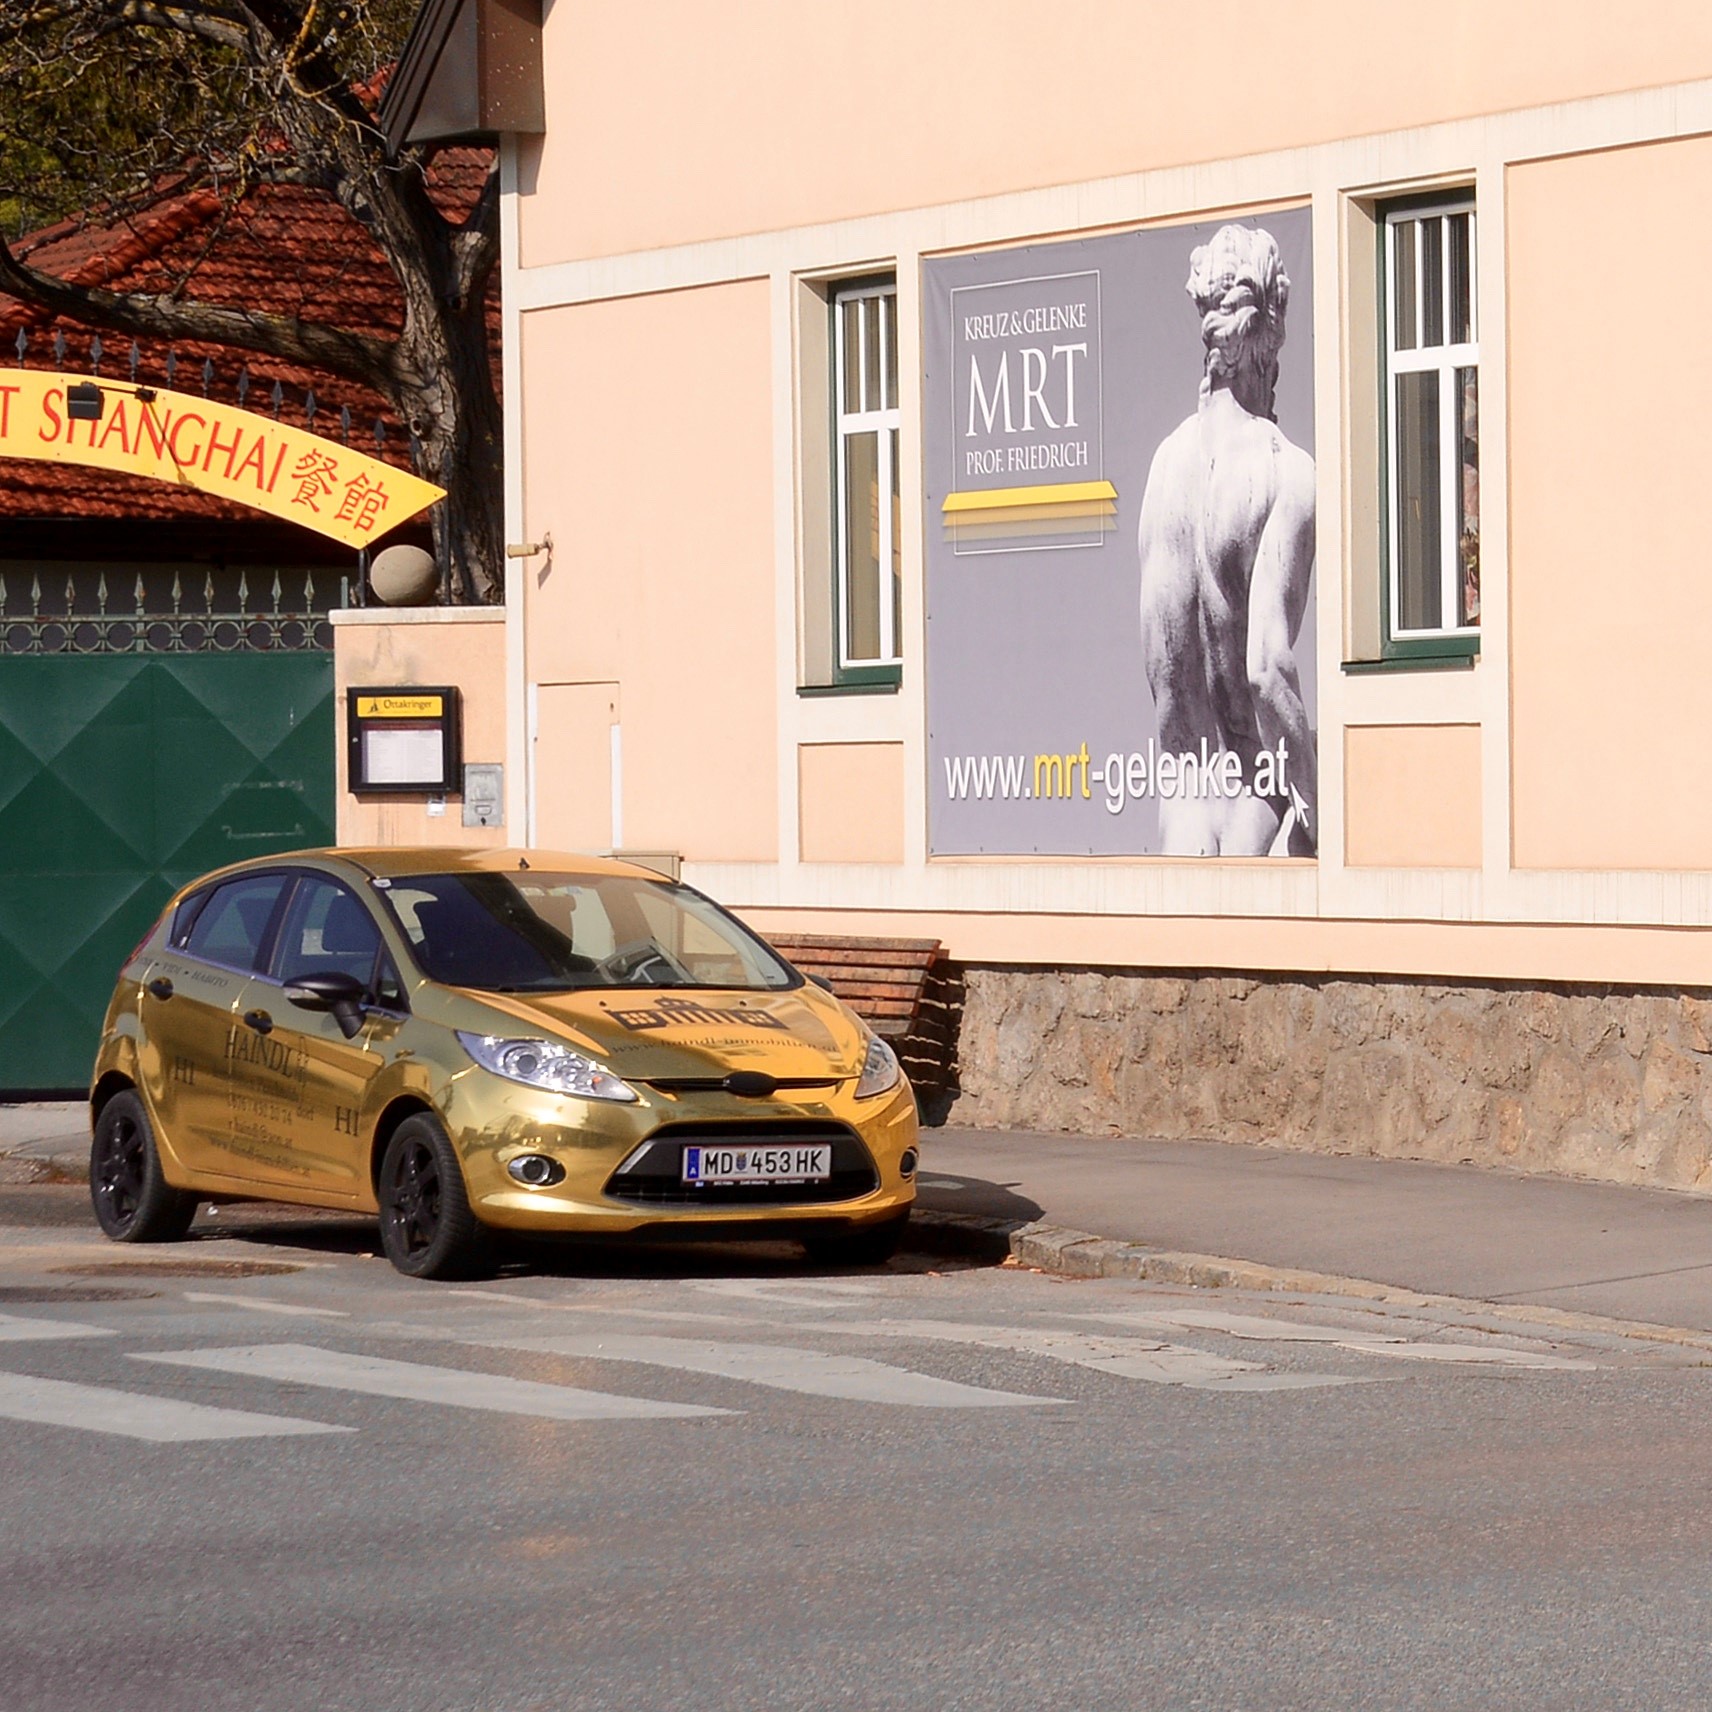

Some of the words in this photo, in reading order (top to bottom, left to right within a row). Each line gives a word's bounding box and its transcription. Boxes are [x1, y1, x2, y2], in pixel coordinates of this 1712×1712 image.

[965, 342, 1088, 437] MRT
[965, 448, 1005, 476] PROF.
[1007, 440, 1088, 472] FRIEDRICH
[290, 447, 390, 533] 餐館
[382, 699, 433, 711] Ottakringer
[943, 736, 1290, 815] www.mrt-gelenke.at
[173, 1056, 196, 1086] HI
[223, 1028, 296, 1079] HAINDL
[334, 1105, 360, 1137] HI
[689, 1166, 697, 1176] A
[704, 1151, 733, 1175] MD
[750, 1150, 791, 1174] 453
[795, 1149, 823, 1173] HK
